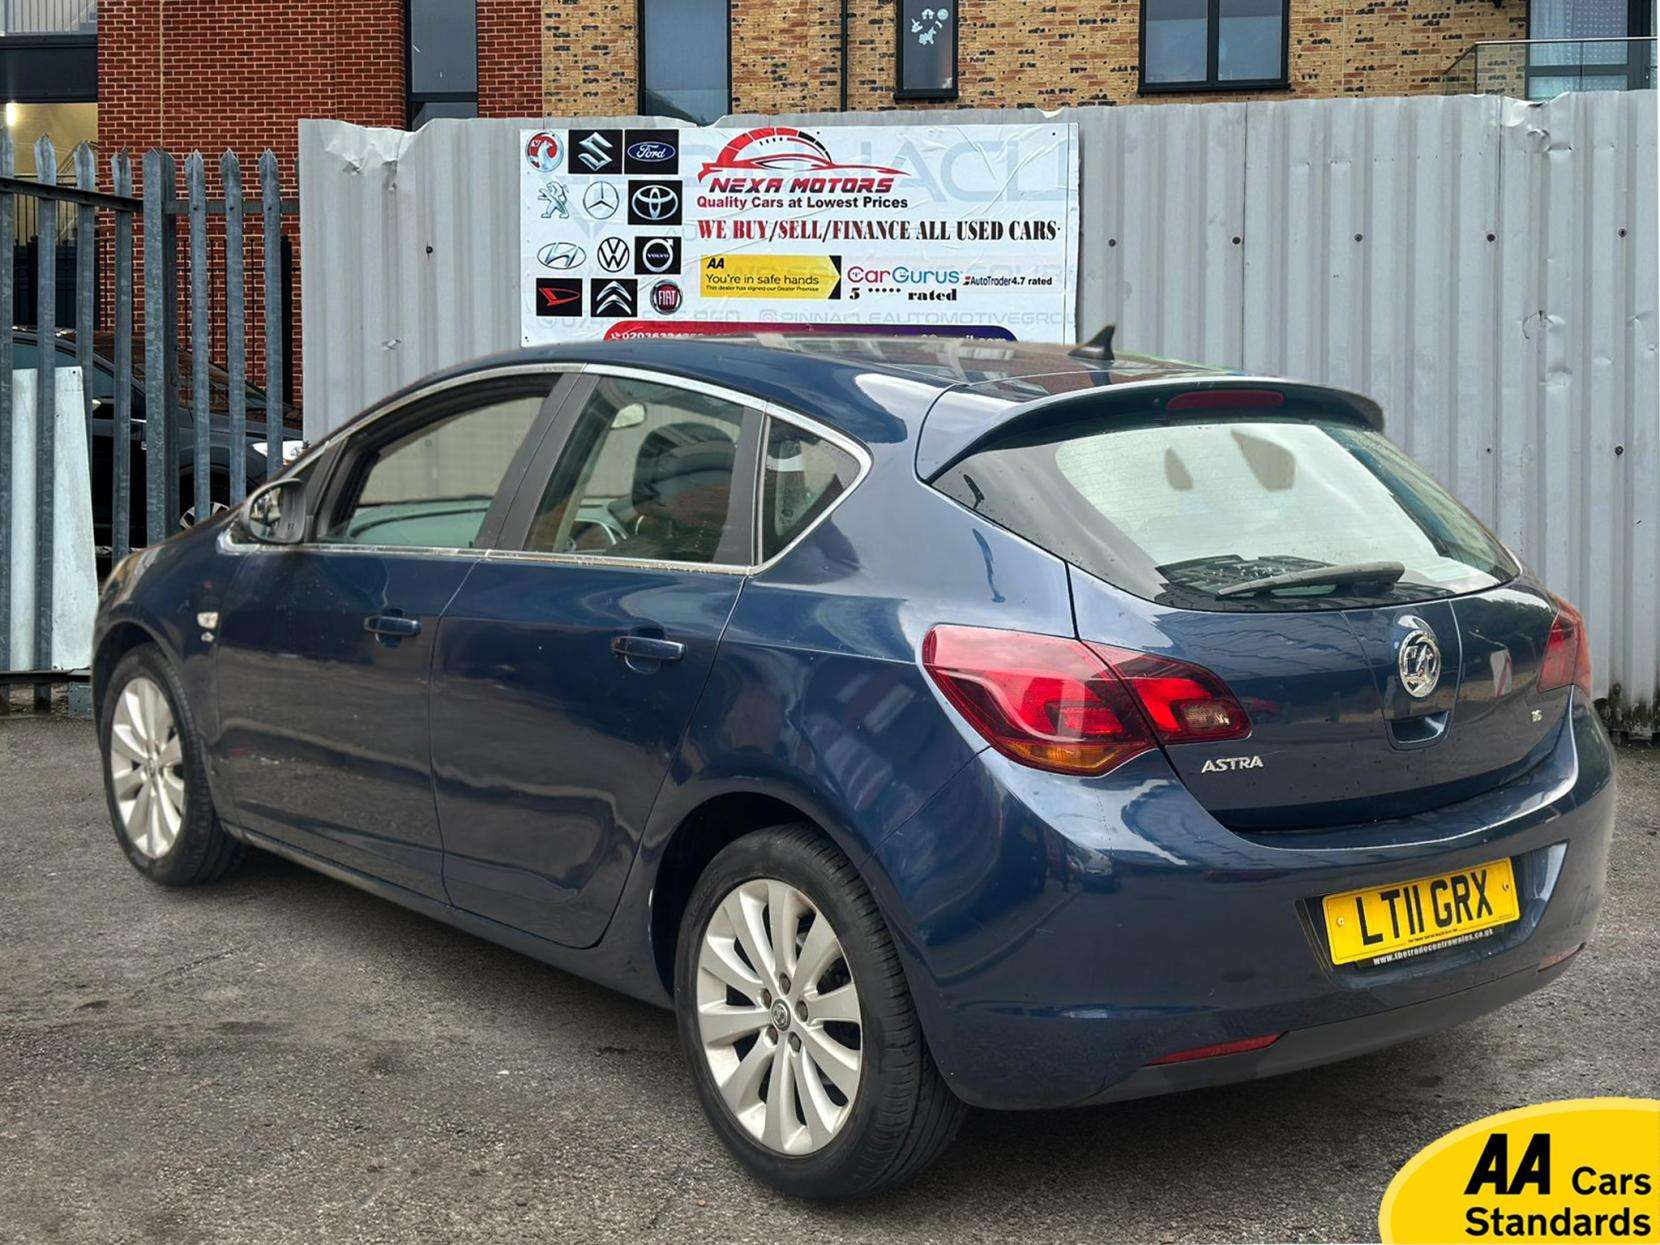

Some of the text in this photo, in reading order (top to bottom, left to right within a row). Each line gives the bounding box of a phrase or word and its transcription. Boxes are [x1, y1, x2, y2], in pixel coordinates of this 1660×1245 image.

[636, 143, 666, 158] Ford
[709, 178, 894, 193] NEXA MOTORS
[697, 196, 908, 210] Quality Cars at Lowest Prices
[697, 220, 727, 240] WE
[733, 220, 911, 243] BUY/SELL/FINANCE
[916, 220, 951, 240] ALL
[957, 220, 1003, 240] USED
[707, 257, 725, 269] AA
[706, 274, 819, 285] You're in safe hands
[847, 266, 960, 284] CarGurus
[1028, 277, 1053, 286] rated
[658, 290, 677, 305] FIAT
[849, 287, 957, 300] 5 rated
[1201, 755, 1264, 774] ASTRA
[1355, 869, 1494, 946] LT11 GRX
